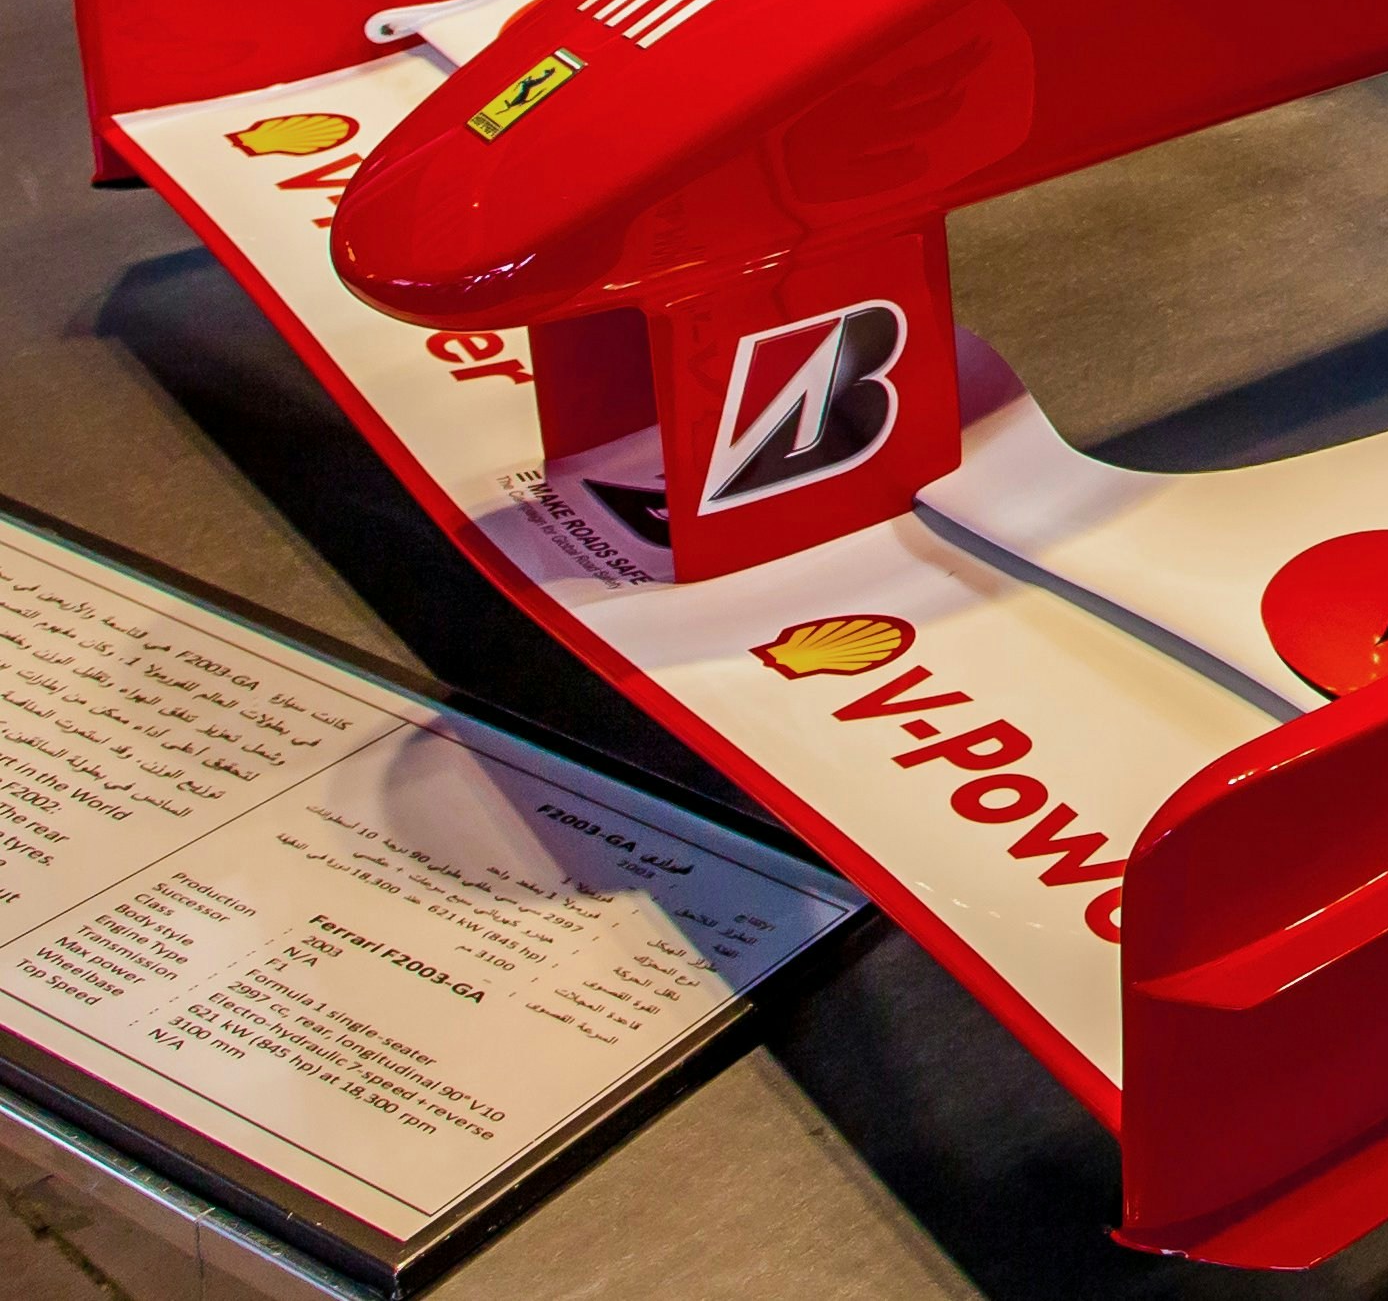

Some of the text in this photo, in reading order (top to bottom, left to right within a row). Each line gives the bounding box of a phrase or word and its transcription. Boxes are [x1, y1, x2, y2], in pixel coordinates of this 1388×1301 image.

[528, 483, 651, 586] MAKE ROADS SAFE
[174, 650, 260, 691] F2003-GA
[191, 692, 240, 709] العالم
[310, 712, 354, 731] كانت
[1, 781, 62, 815] F2002:
[14, 762, 133, 821] in the World
[24, 821, 70, 843] rear
[357, 828, 379, 840] 10
[535, 803, 637, 853] F2003-GA
[3, 836, 54, 867] tyres.
[408, 851, 431, 864] 90
[133, 893, 175, 917] Class
[151, 882, 231, 923] Successor
[171, 872, 256, 917] Production
[94, 914, 188, 965] Engine Type
[114, 903, 194, 946] Body style
[427, 905, 457, 921] 621
[456, 917, 485, 933] kW
[481, 930, 520, 950] (845
[518, 946, 547, 964] hp)
[542, 913, 584, 933] 2997
[54, 936, 146, 984] Max power
[76, 924, 178, 981] Transmission
[264, 957, 288, 972] F1
[282, 946, 319, 968] N/A
[301, 936, 344, 958] 2003
[308, 914, 485, 1004] Ferrari F2003-GA
[475, 950, 516, 971] 3100
[16, 958, 103, 1006] Top Speed
[36, 946, 125, 996] Wheelbase
[168, 1016, 246, 1059] 3100 mm
[245, 968, 437, 1066] Formula 1 single-seater
[147, 1028, 185, 1051] N/A
[227, 981, 272, 1003] 2997
[269, 1003, 290, 1019] cc,
[294, 1016, 334, 1040] rear,
[334, 1034, 442, 1091] longitudinal
[469, 1099, 506, 1122] V10
[187, 1004, 437, 1135] 621 kW (845 hp) at 18,300 rpm
[208, 992, 348, 1067] Electro-hydraulic
[346, 1061, 419, 1101] 7-speed
[426, 1104, 494, 1141] reverse
